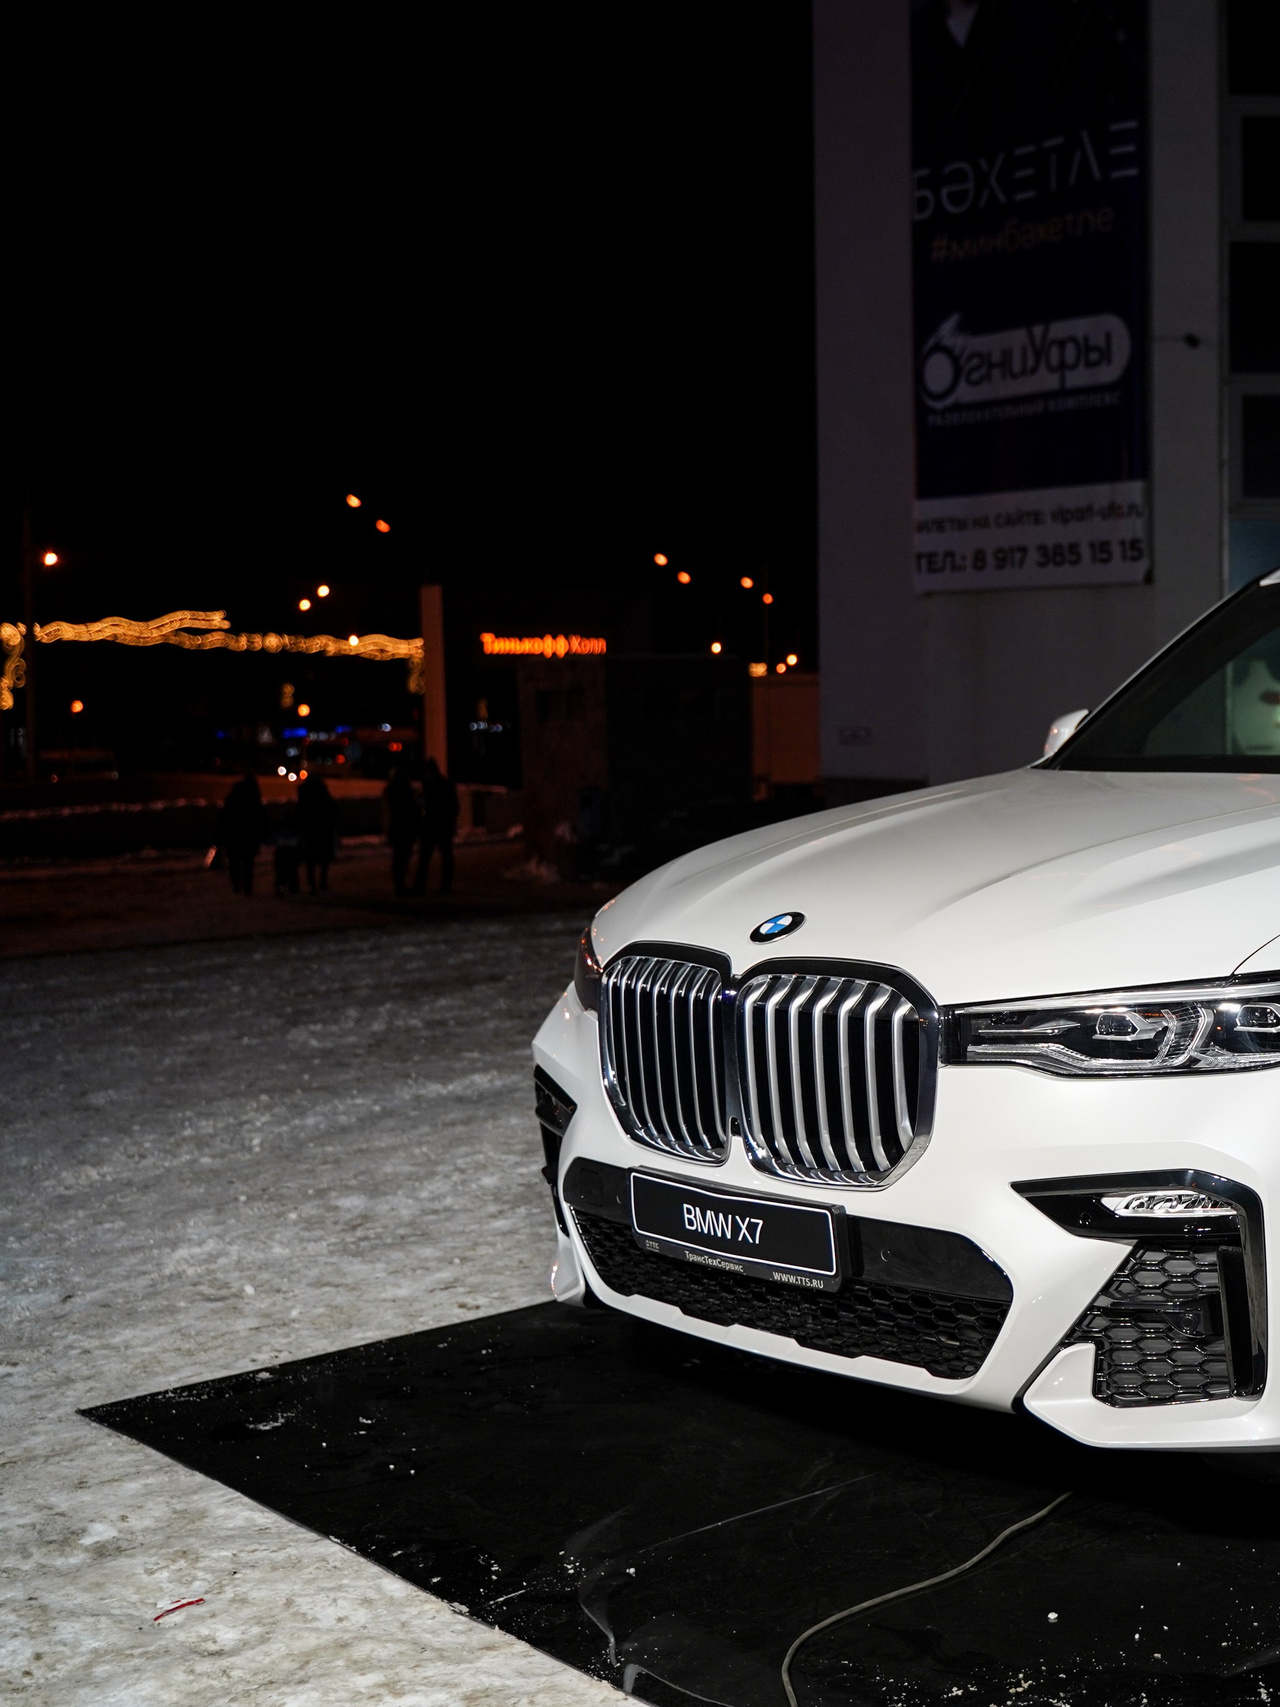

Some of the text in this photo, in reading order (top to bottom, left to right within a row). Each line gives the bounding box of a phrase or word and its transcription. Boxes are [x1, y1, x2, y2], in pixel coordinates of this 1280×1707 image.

[971, 514, 991, 530] НА
[972, 548, 987, 572] 8
[993, 546, 1030, 570] 917
[1089, 539, 1114, 566] 15
[1119, 537, 1145, 563] 15
[480, 632, 569, 659] Тинькофф
[682, 1203, 764, 1245] BMW X7
[684, 1250, 744, 1273] ТрансТехСервис
[772, 1271, 825, 1289] WWW.TTS.RU
